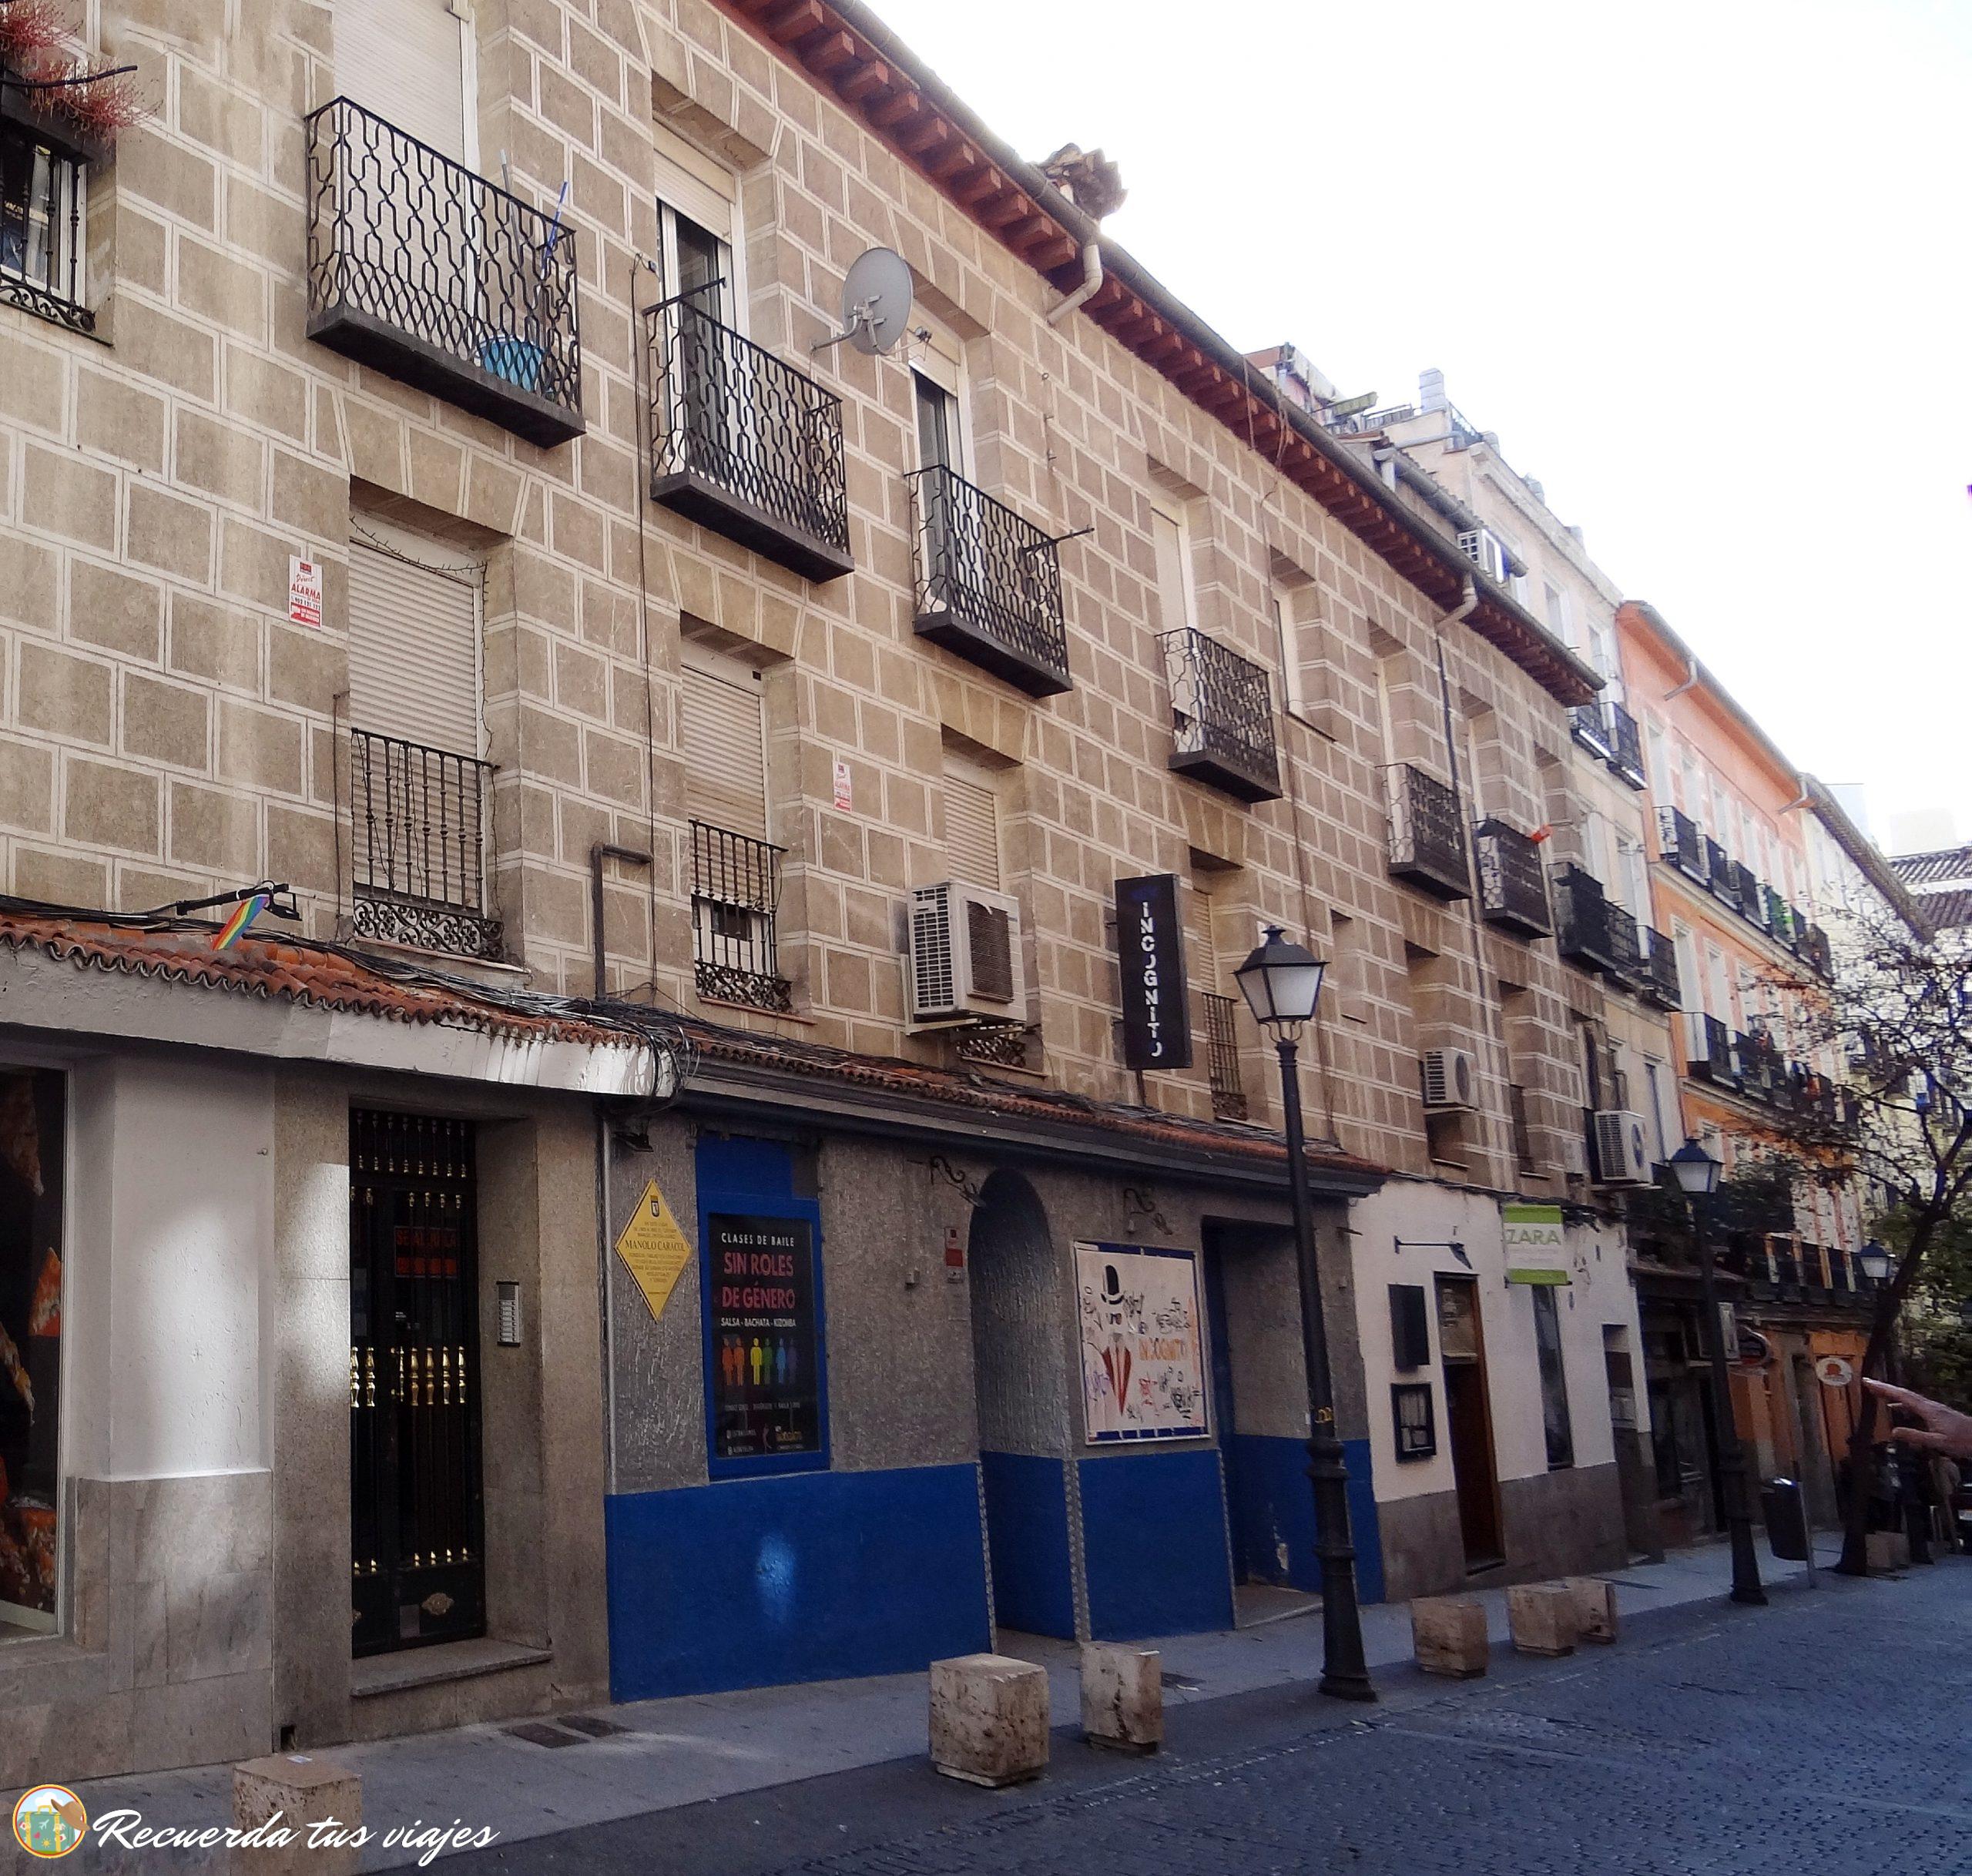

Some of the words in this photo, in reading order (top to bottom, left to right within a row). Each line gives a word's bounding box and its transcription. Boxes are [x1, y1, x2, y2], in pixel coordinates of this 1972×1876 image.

[290, 584, 320, 601] ALARMA
[1140, 901, 1162, 1057] INCOGNITO
[625, 1239, 656, 1250] MANOLO
[721, 1232, 753, 1245] CLASES
[756, 1234, 767, 1245] DE
[771, 1236, 795, 1247] BAILE
[723, 1251, 746, 1275] SIN
[750, 1253, 794, 1277] ROLES
[722, 1286, 740, 1308] DE
[742, 1280, 796, 1309] GÉNERO
[720, 1317, 740, 1327] SALSA
[744, 1318, 771, 1327] BACHATA
